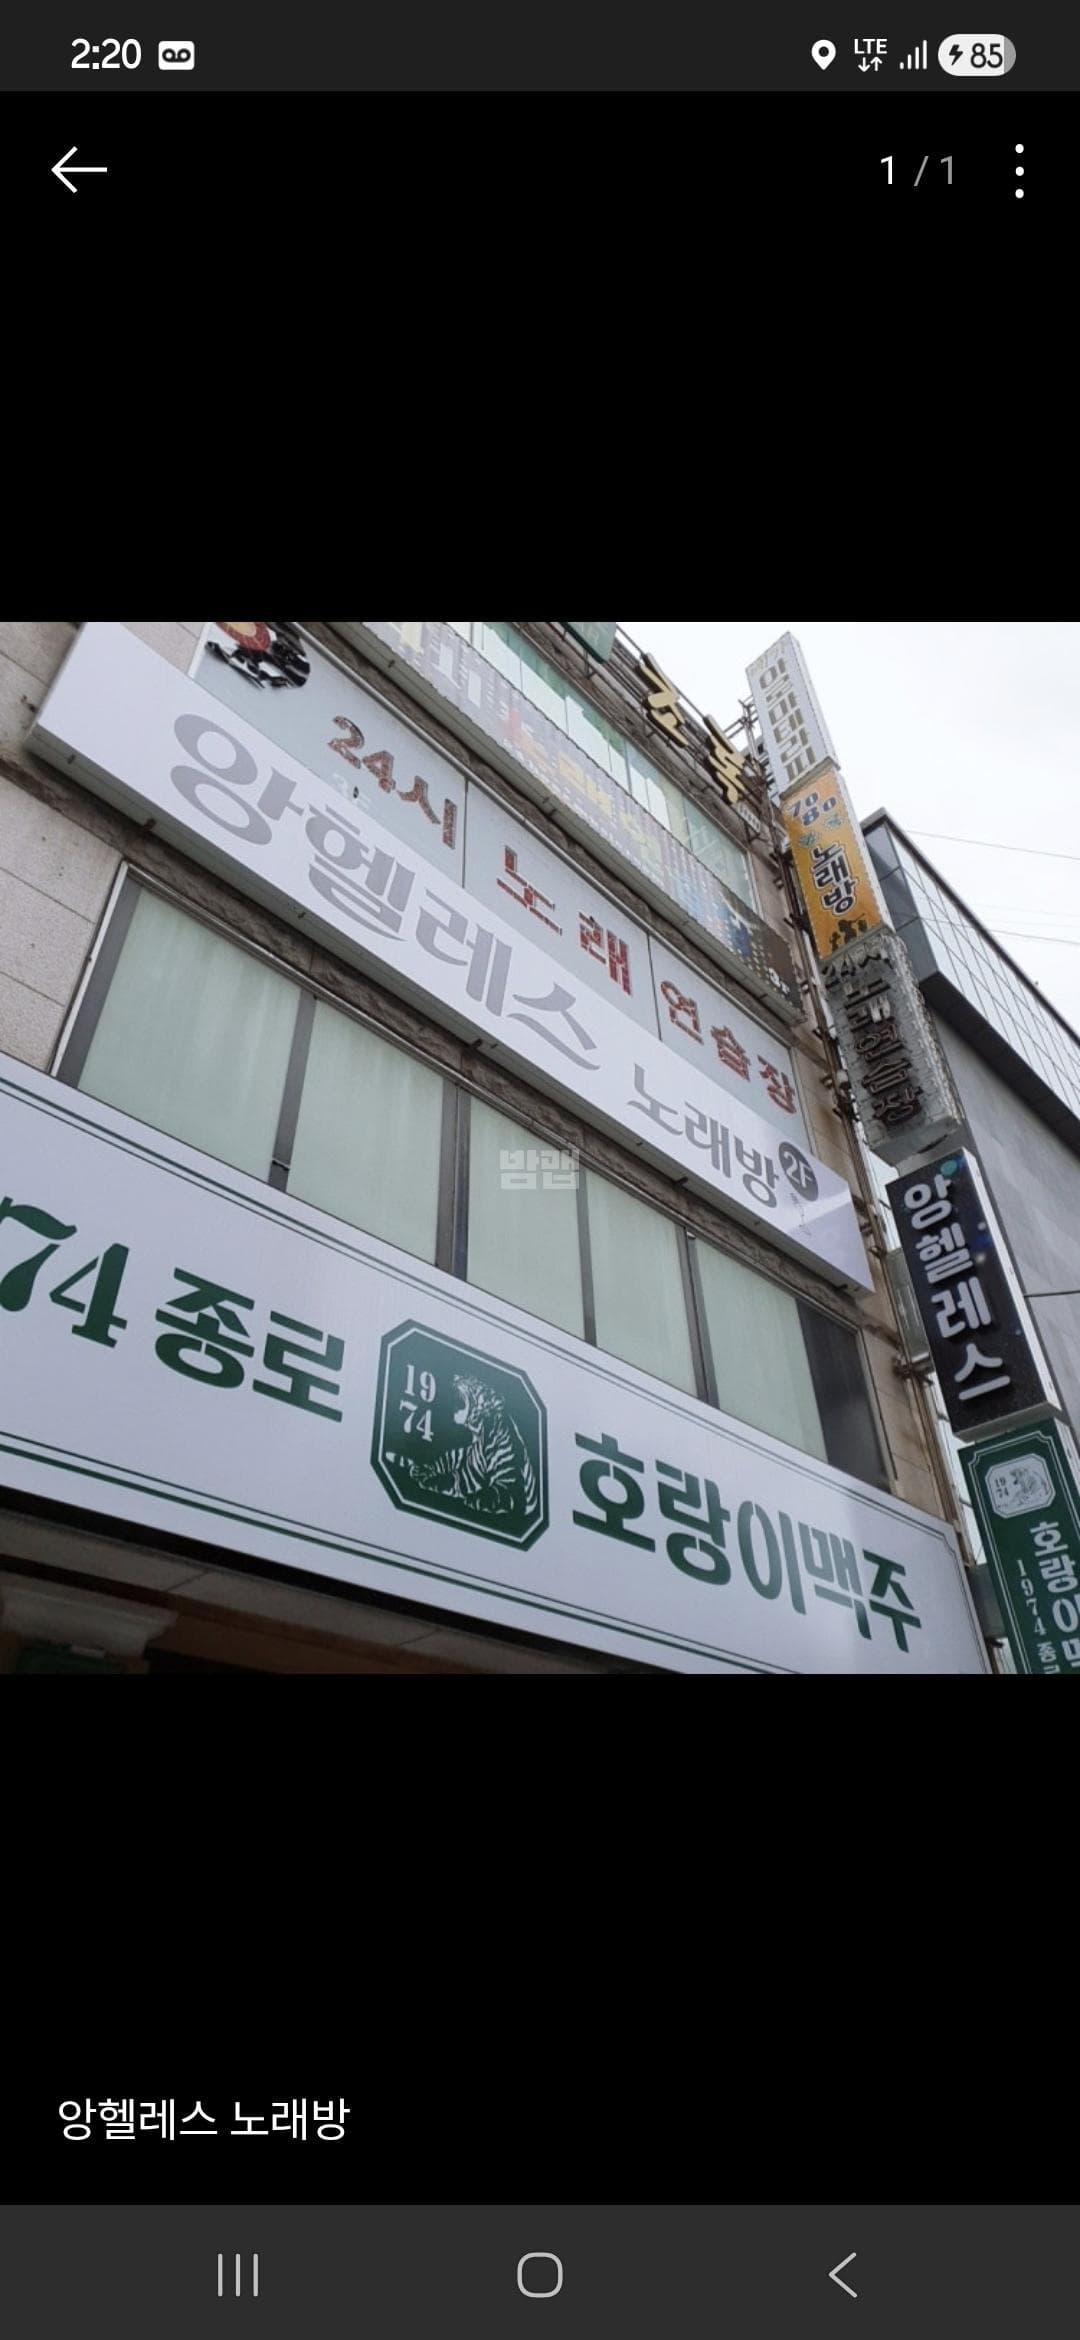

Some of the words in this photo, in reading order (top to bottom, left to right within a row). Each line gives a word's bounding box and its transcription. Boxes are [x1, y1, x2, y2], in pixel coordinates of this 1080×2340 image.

[759, 658, 816, 782] 아로마테라피
[327, 715, 458, 850] 24시
[812, 843, 857, 914] 노래방
[170, 713, 601, 1071] 앙헬레스
[627, 1062, 780, 1209] 노래방
[782, 1152, 815, 1189] 2F
[903, 1174, 1011, 1402] 앙헬레스
[399, 1402, 435, 1442] 74
[403, 1364, 437, 1402] 19
[154, 1267, 346, 1423] 종로
[571, 1432, 922, 1654] 호랑이맥주
[1017, 1559, 1047, 1636] 1974
